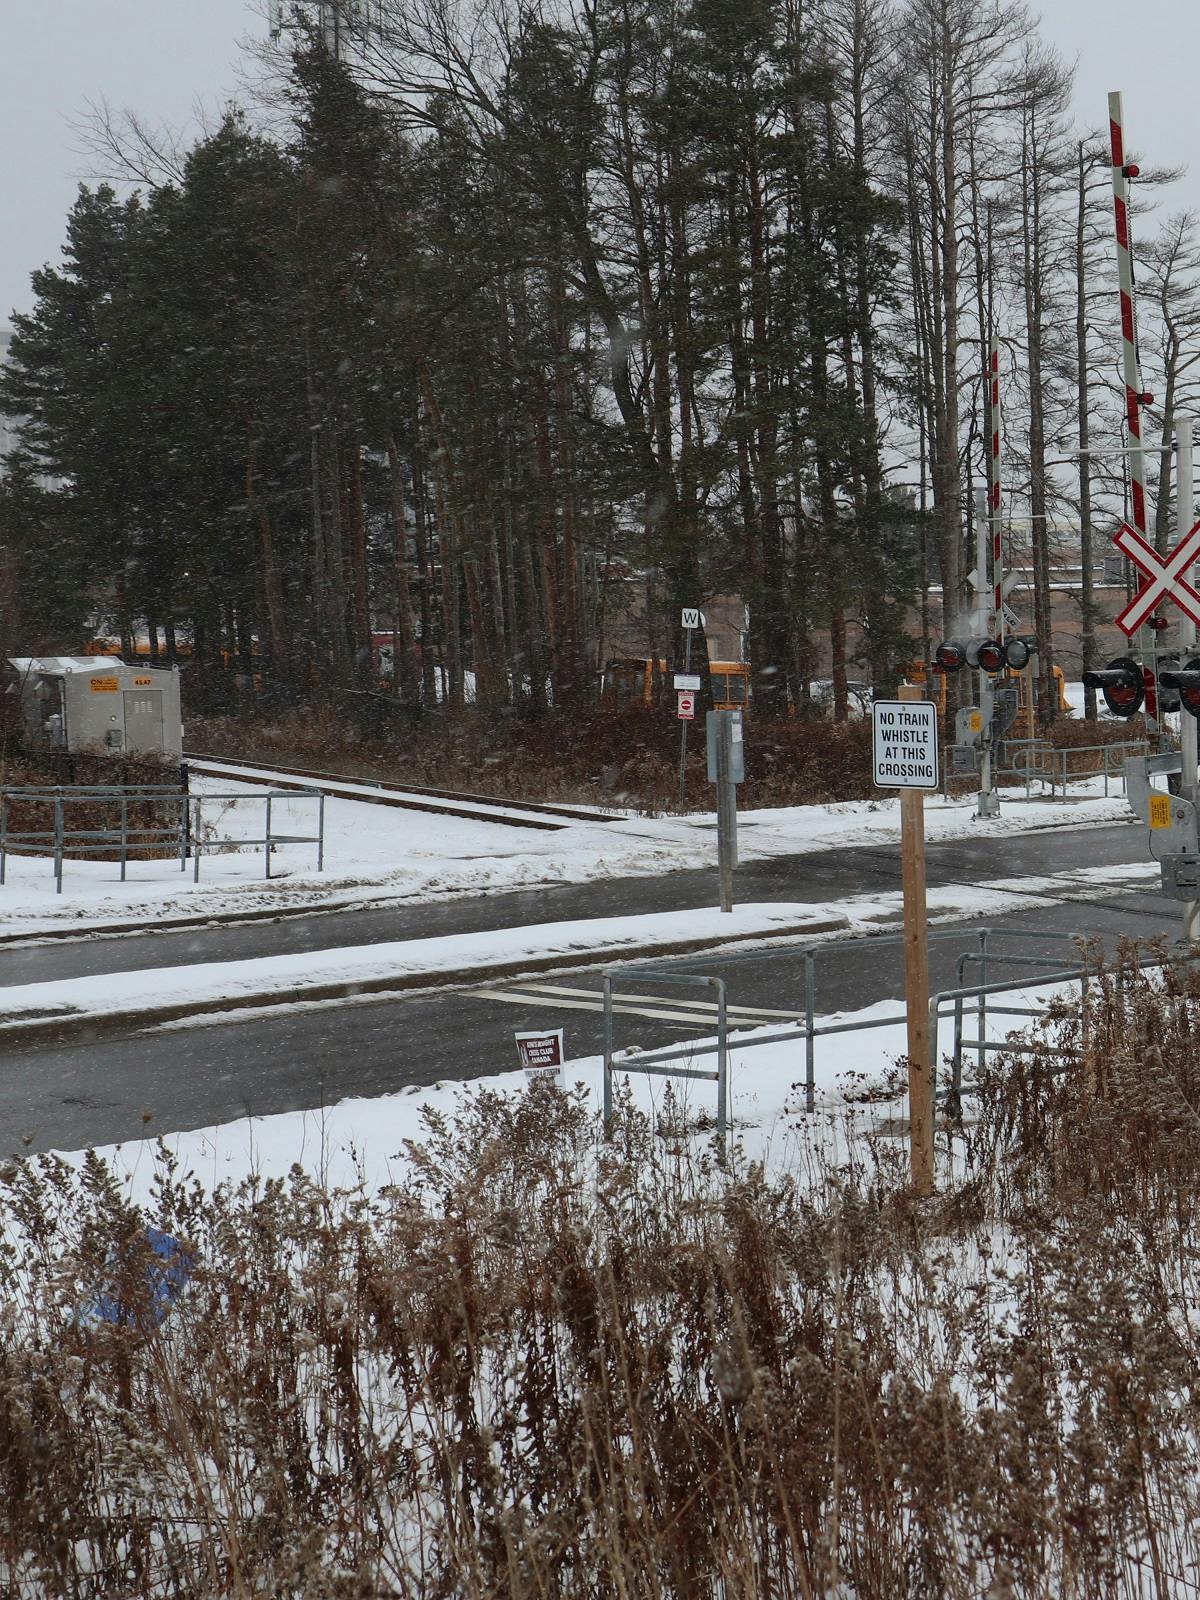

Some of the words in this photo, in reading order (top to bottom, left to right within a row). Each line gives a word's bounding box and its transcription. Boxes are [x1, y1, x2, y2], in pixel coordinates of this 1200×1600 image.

[683, 612, 697, 625] W
[880, 713, 894, 725] NO
[898, 713, 929, 726] TRAIN
[882, 730, 928, 743] WHISTLE
[885, 747, 898, 759] AT
[902, 747, 925, 760] THIS
[879, 763, 932, 777] CROSSING
